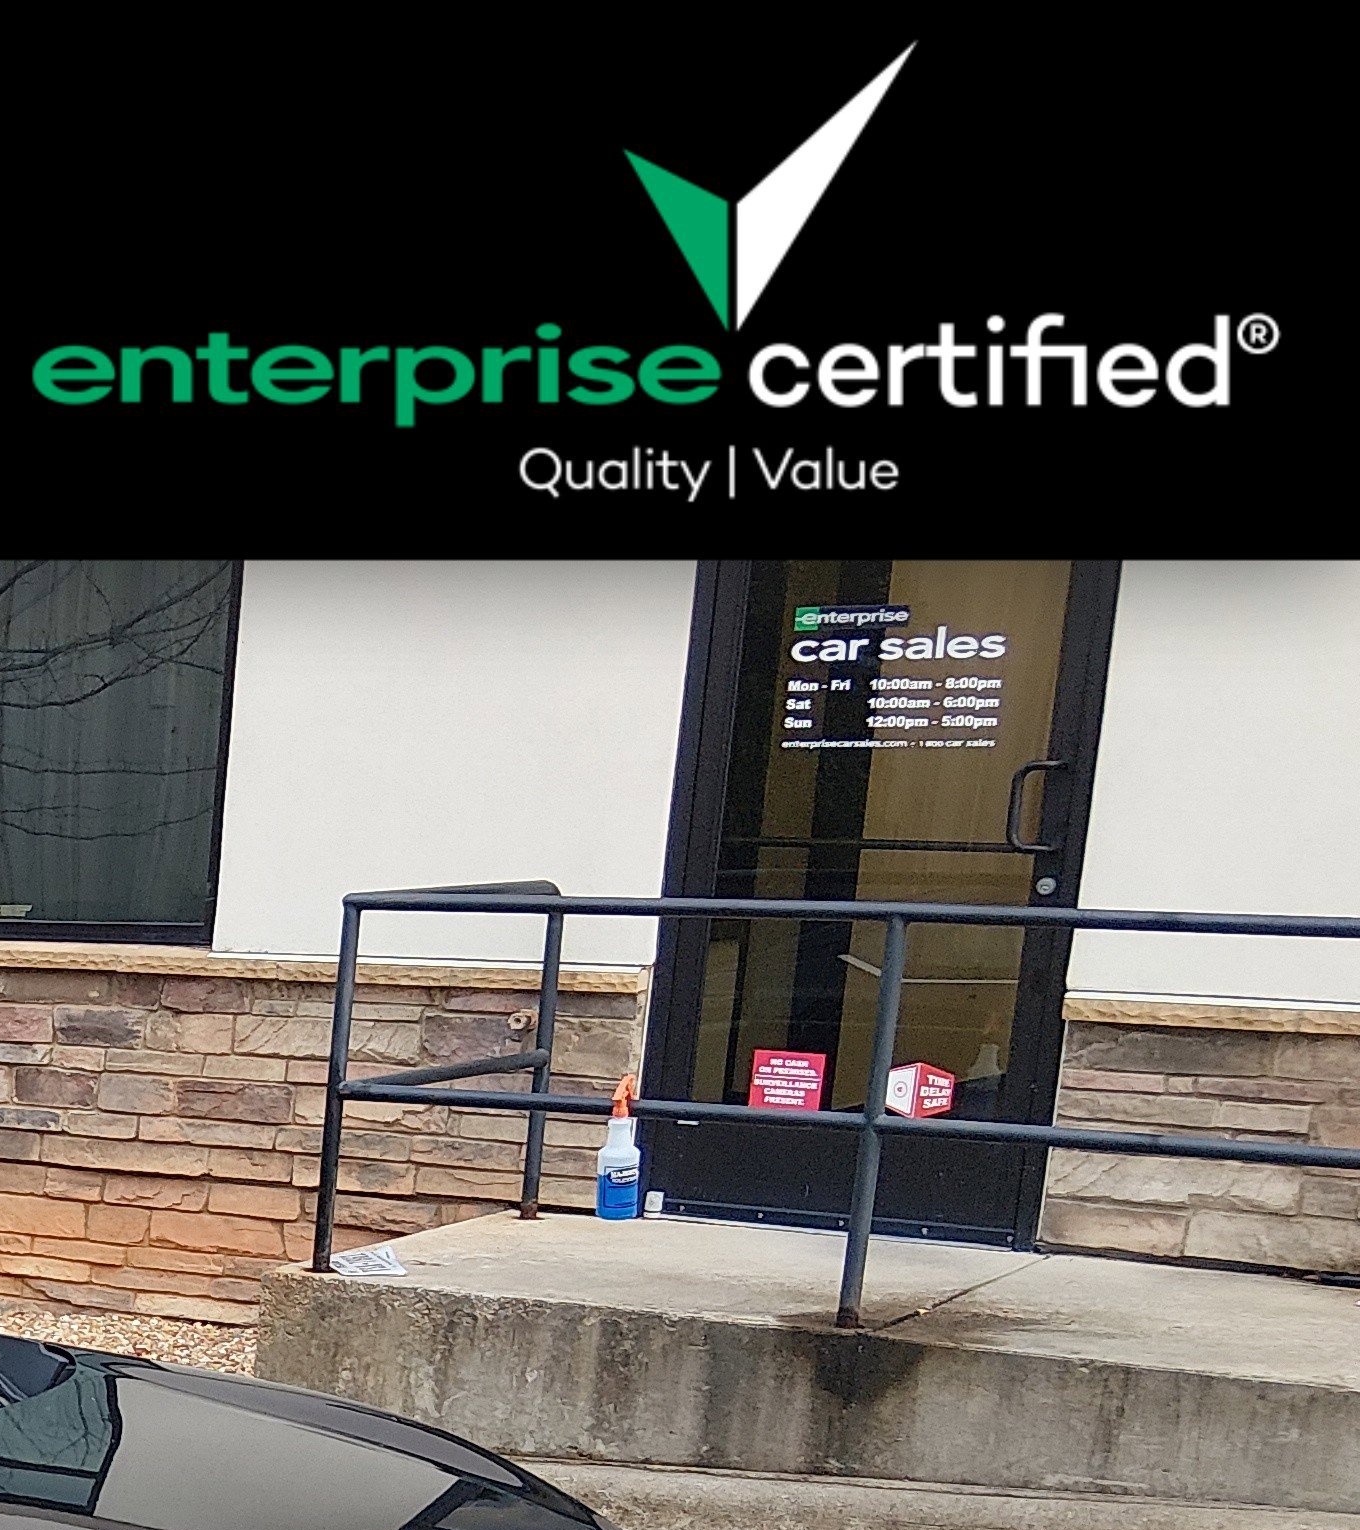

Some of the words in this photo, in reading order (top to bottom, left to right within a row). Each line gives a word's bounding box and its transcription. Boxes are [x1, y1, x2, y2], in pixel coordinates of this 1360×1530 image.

[795, 609, 910, 626] enterprise
[791, 638, 869, 662] car
[878, 626, 1007, 660] sales
[787, 680, 819, 692] Mon
[831, 679, 852, 691] Fri
[869, 678, 932, 691] 10:00am
[945, 677, 1003, 693] 8:00pm
[786, 699, 811, 709] Sat
[867, 697, 930, 709] 10:00am
[943, 696, 1000, 710] 6:00pm
[784, 717, 812, 728] Sun
[865, 716, 929, 729] 12:00pm
[941, 715, 998, 729] 5:00pm
[781, 739, 908, 750] enterprisecarsales.com
[945, 740, 964, 748] car
[966, 738, 996, 748] sales
